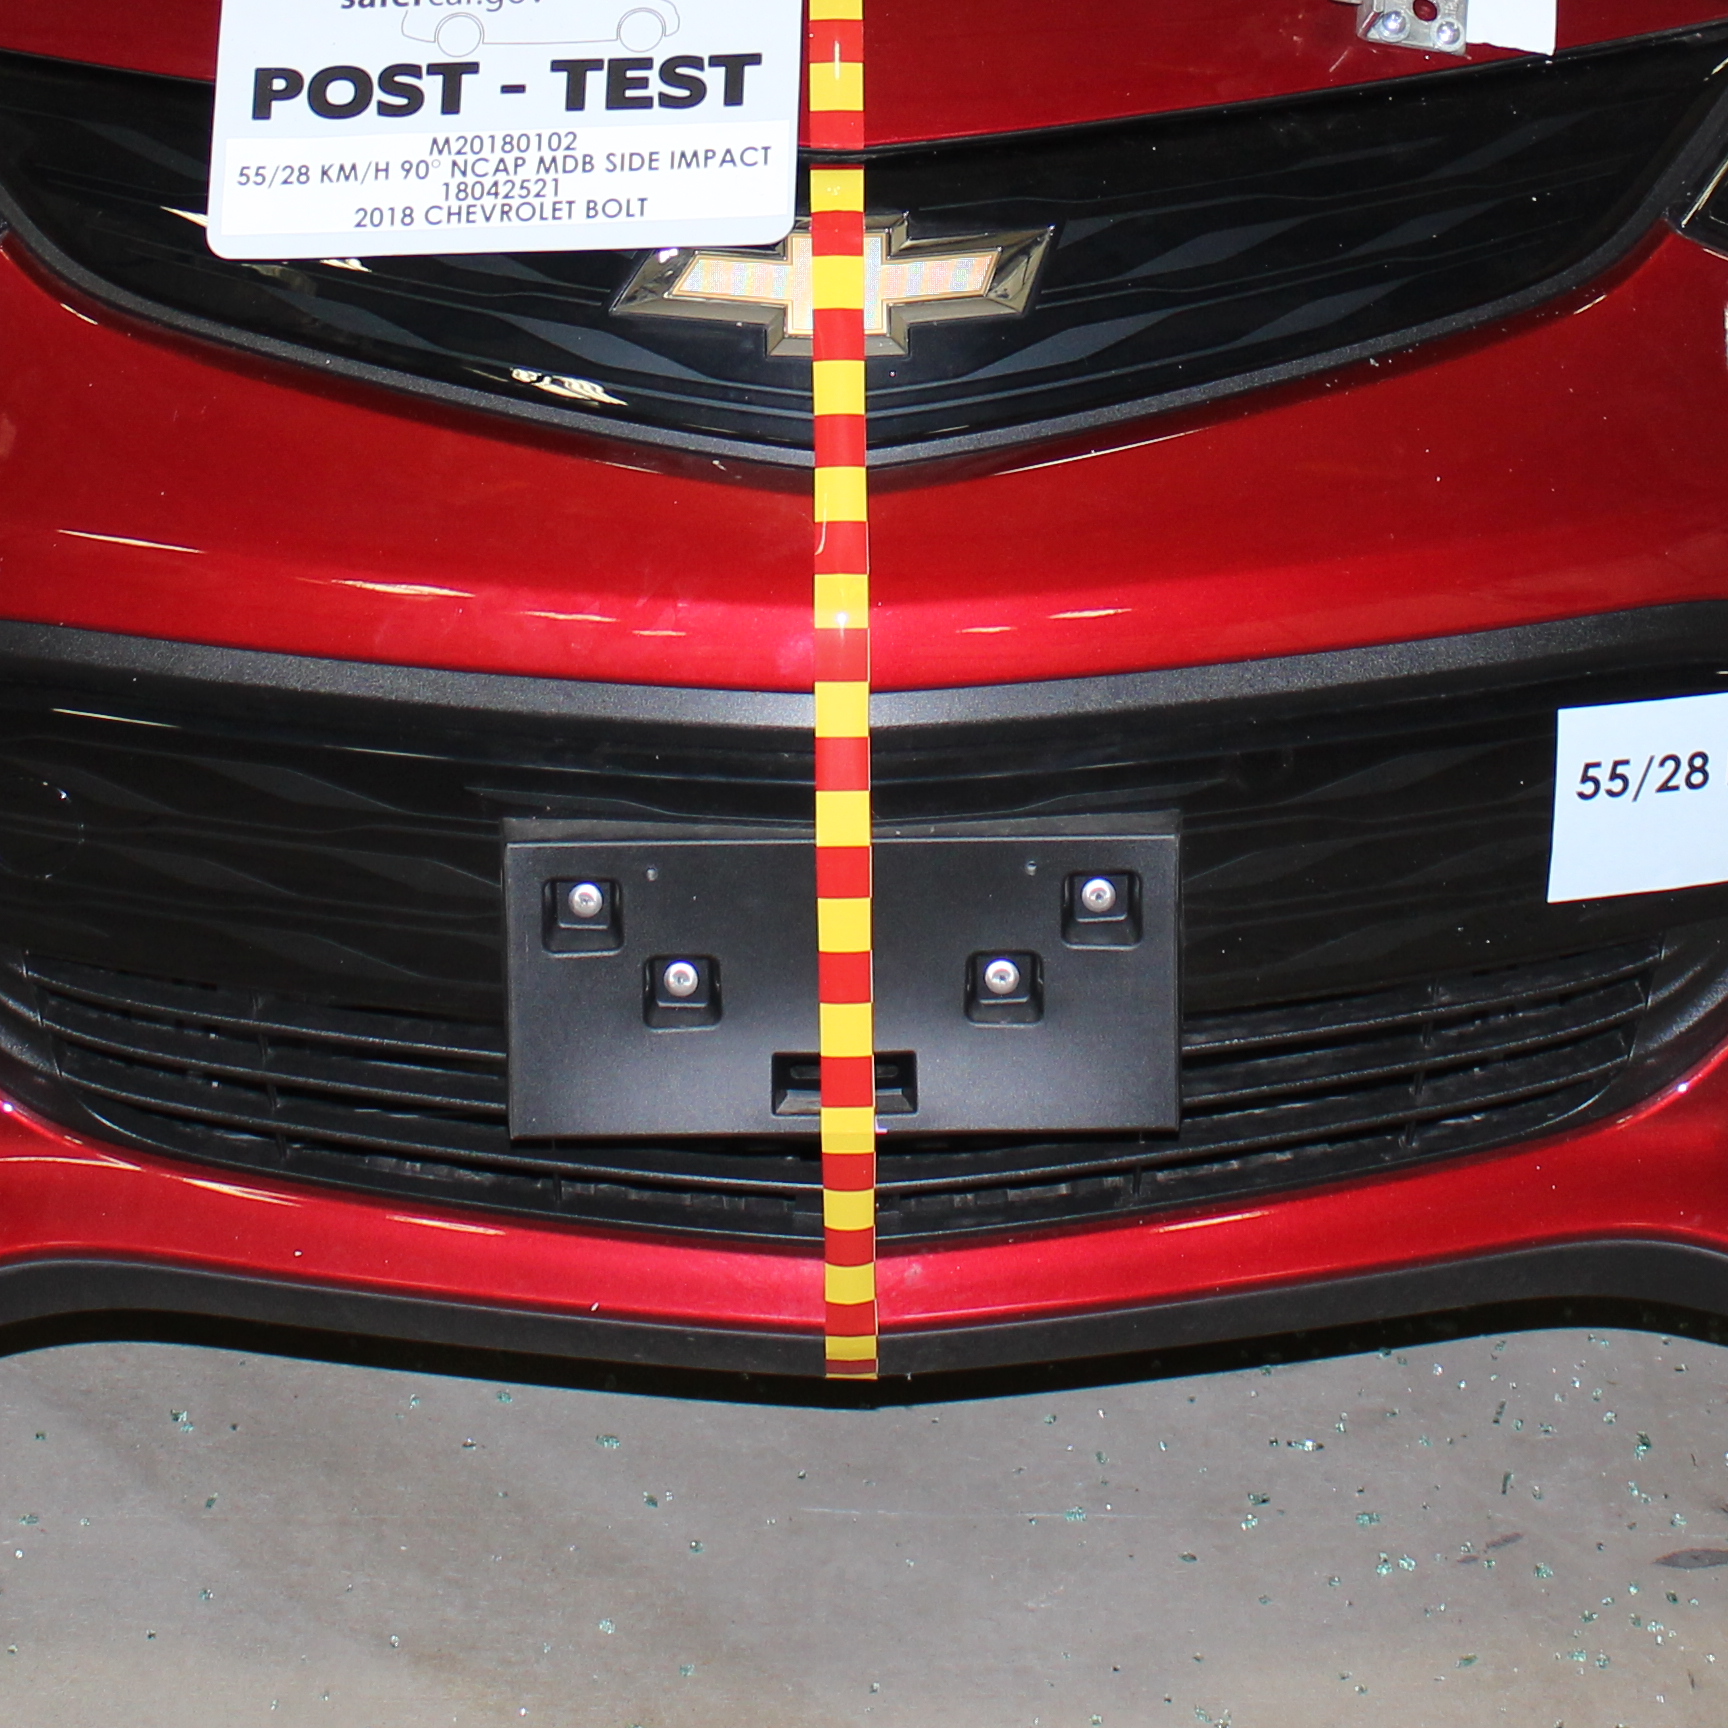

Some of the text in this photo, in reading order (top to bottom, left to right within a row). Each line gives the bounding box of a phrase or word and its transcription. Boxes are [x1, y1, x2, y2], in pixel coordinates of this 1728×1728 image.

[251, 61, 481, 121] POST
[549, 52, 763, 112] TEST
[429, 131, 577, 156] M20180102
[237, 163, 311, 187] 55/28
[320, 159, 391, 183] KM/H
[451, 156, 527, 178] NCAP
[536, 154, 595, 174] MDB
[605, 151, 660, 173] SIDE
[670, 146, 772, 169] IMPACT
[442, 178, 560, 202] 18042521
[355, 197, 648, 228] 2018 CHEVROLET BOLT
[1576, 751, 1711, 804] 55/28
